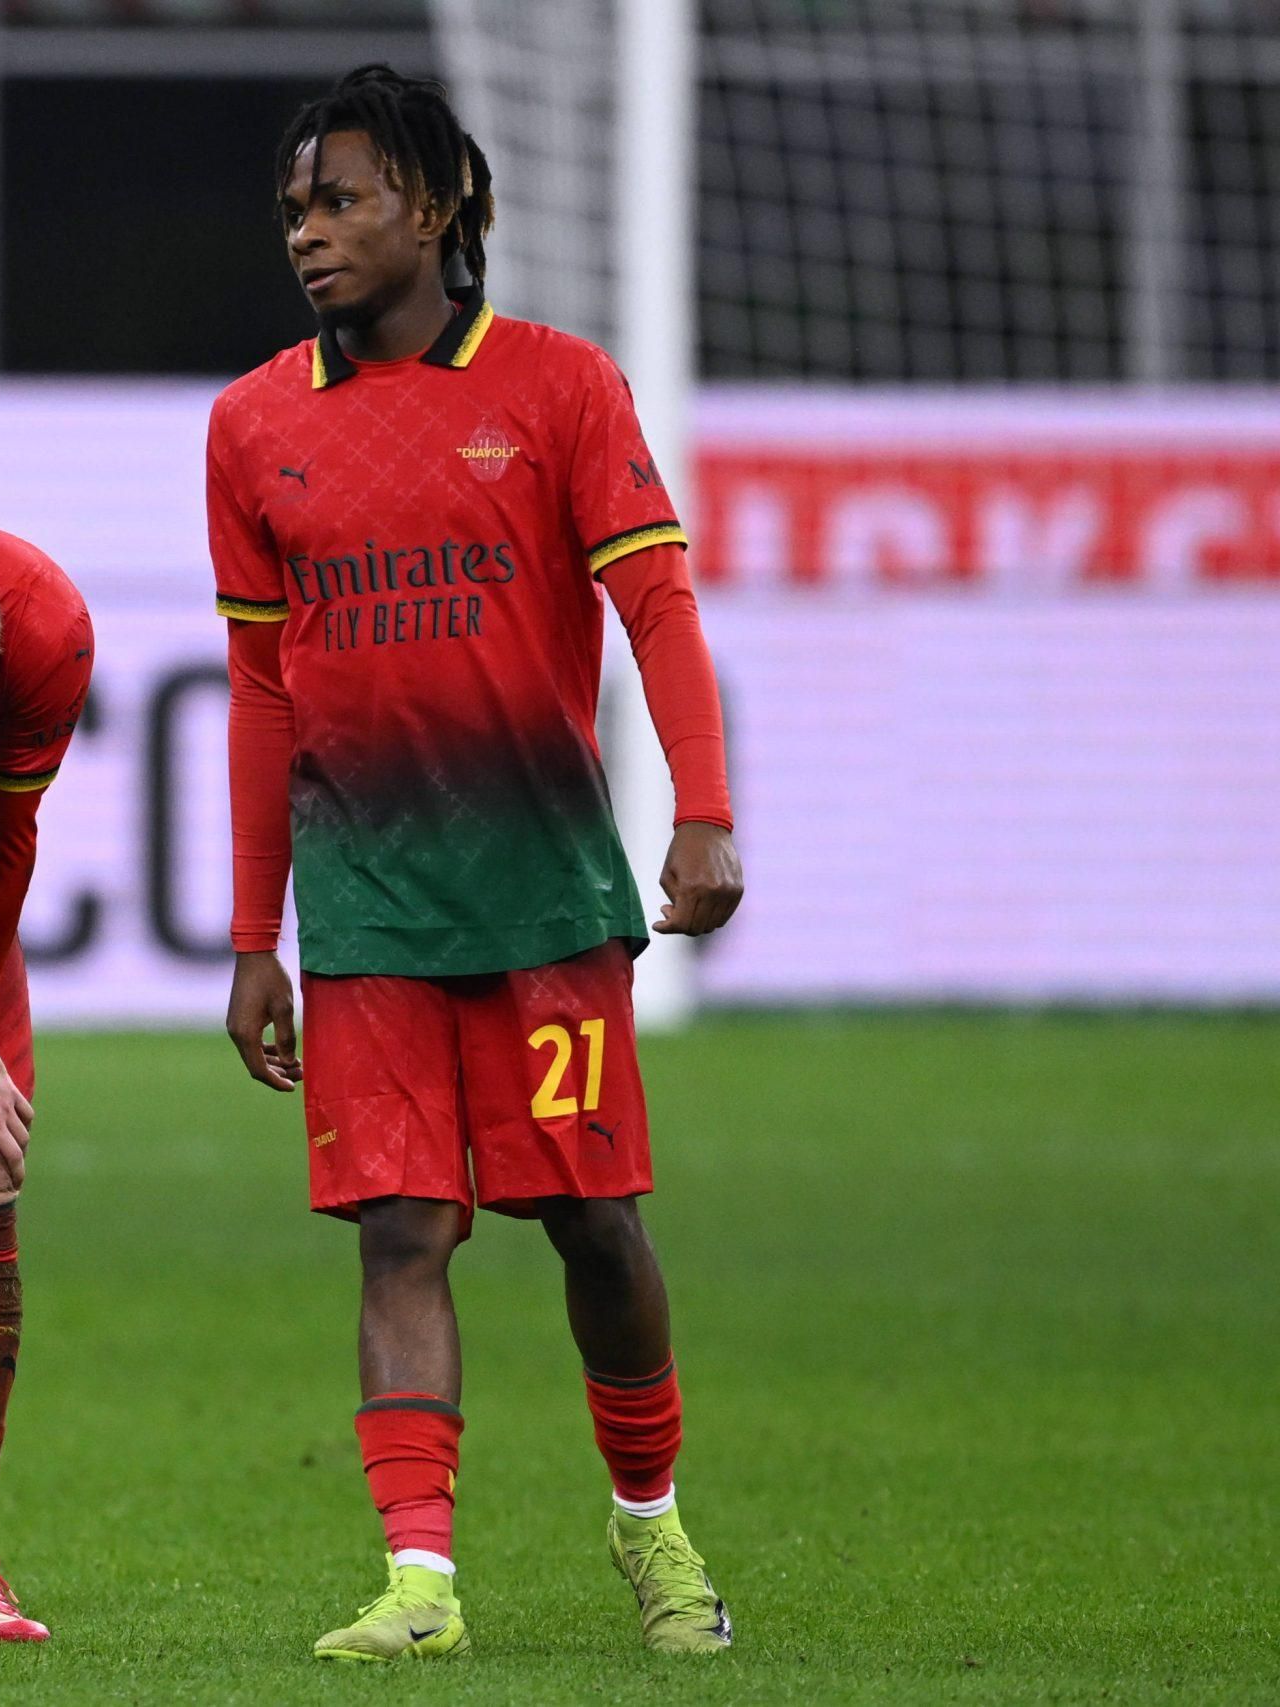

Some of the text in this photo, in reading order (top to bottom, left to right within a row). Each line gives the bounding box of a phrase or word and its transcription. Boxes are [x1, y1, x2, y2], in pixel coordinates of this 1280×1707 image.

[455, 446, 520, 459] "DIAVOLI"
[286, 537, 516, 605] Emirates
[324, 594, 482, 652] FLY BETTER
[527, 1018, 606, 1119] 21
